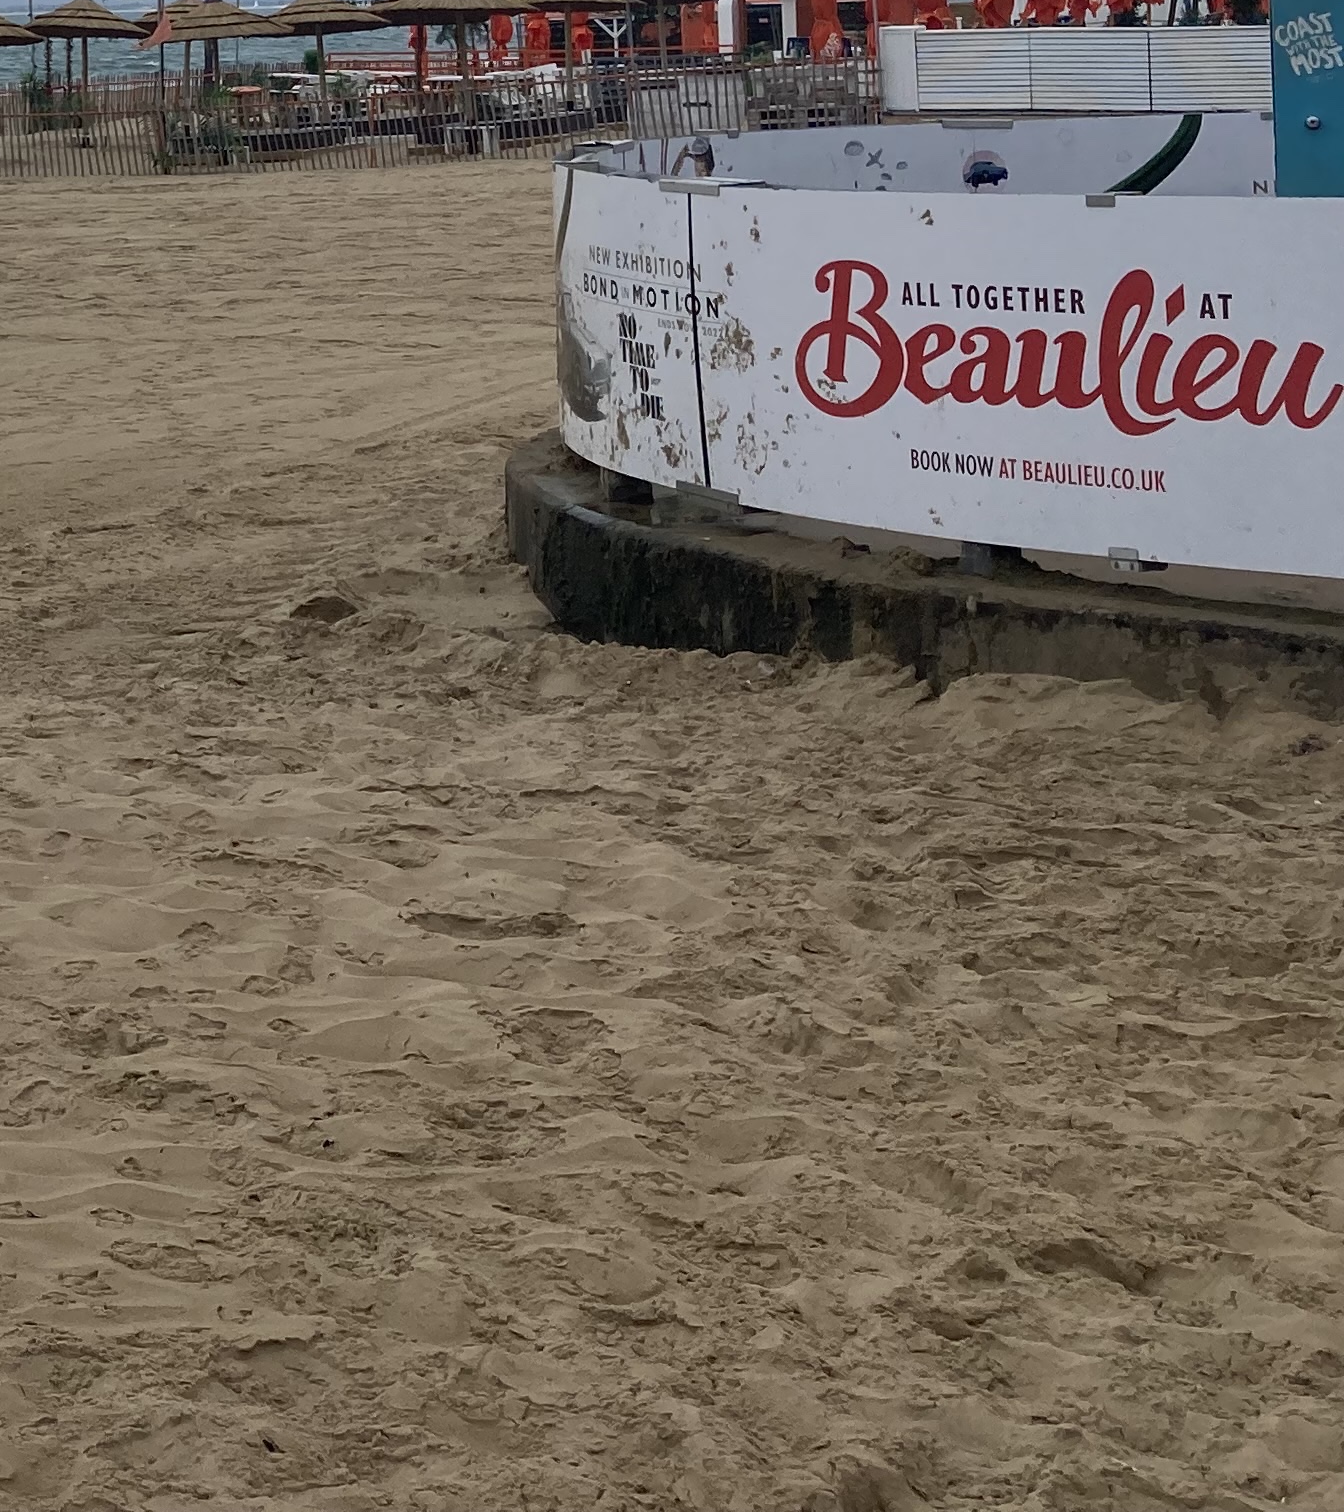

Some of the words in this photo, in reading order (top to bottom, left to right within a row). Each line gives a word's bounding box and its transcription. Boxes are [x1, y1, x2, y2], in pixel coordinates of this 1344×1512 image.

[1274, 12, 1332, 46] COAST
[1285, 39, 1311, 57] WITH
[1310, 34, 1338, 48] THE
[1290, 45, 1344, 76] MOST
[589, 244, 610, 266] NEW
[615, 250, 702, 282] EXHIBITION
[583, 273, 619, 300] BOND
[632, 283, 720, 319] MOTION
[901, 281, 940, 308] ALL
[952, 283, 1085, 315] TOGETHER
[1199, 293, 1233, 320] AT
[617, 312, 637, 339] NO
[619, 338, 656, 369] TIME
[795, 259, 1344, 437] Beaulieu
[629, 365, 650, 394] TO
[910, 449, 951, 474] BOOK
[954, 453, 994, 478] NOW
[998, 457, 1017, 479] AT
[1022, 460, 1167, 493] BEAULIEU.CO.UK
